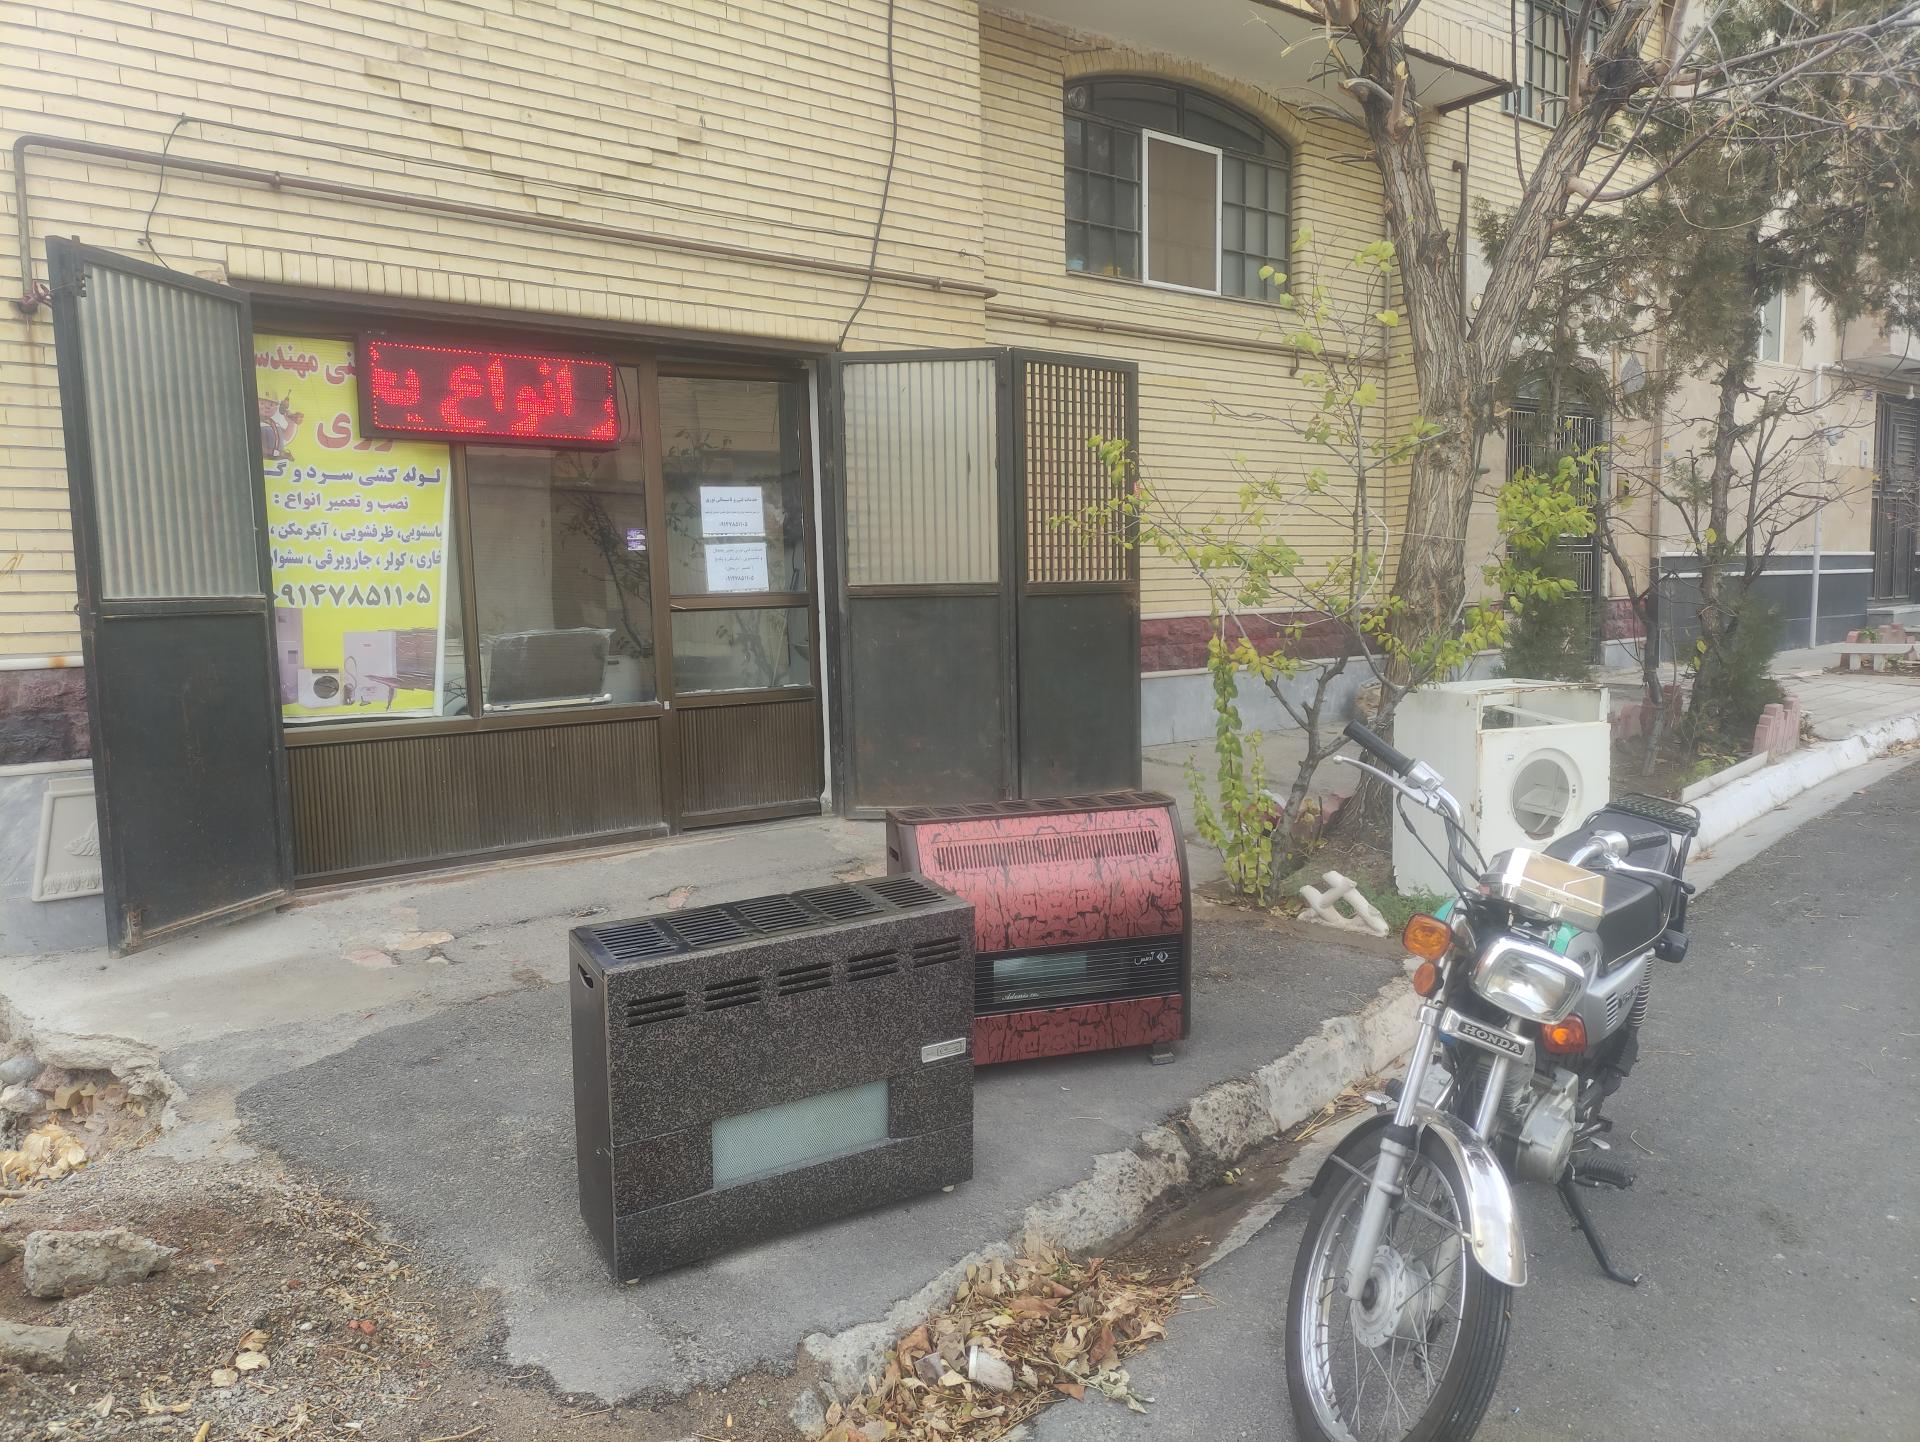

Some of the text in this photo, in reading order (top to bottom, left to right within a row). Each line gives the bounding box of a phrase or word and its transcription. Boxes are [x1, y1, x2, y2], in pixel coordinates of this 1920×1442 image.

[255, 344, 319, 379] مهندس
[440, 357, 574, 432] انواع
[292, 468, 301, 483] و
[306, 466, 353, 485] سرد
[358, 467, 397, 486] کشی
[402, 466, 441, 487] لوله
[325, 495, 361, 511] تعمیر
[365, 501, 373, 512] و
[377, 496, 409, 512] نصب
[1462, 1023, 1522, 1055] HONDA
